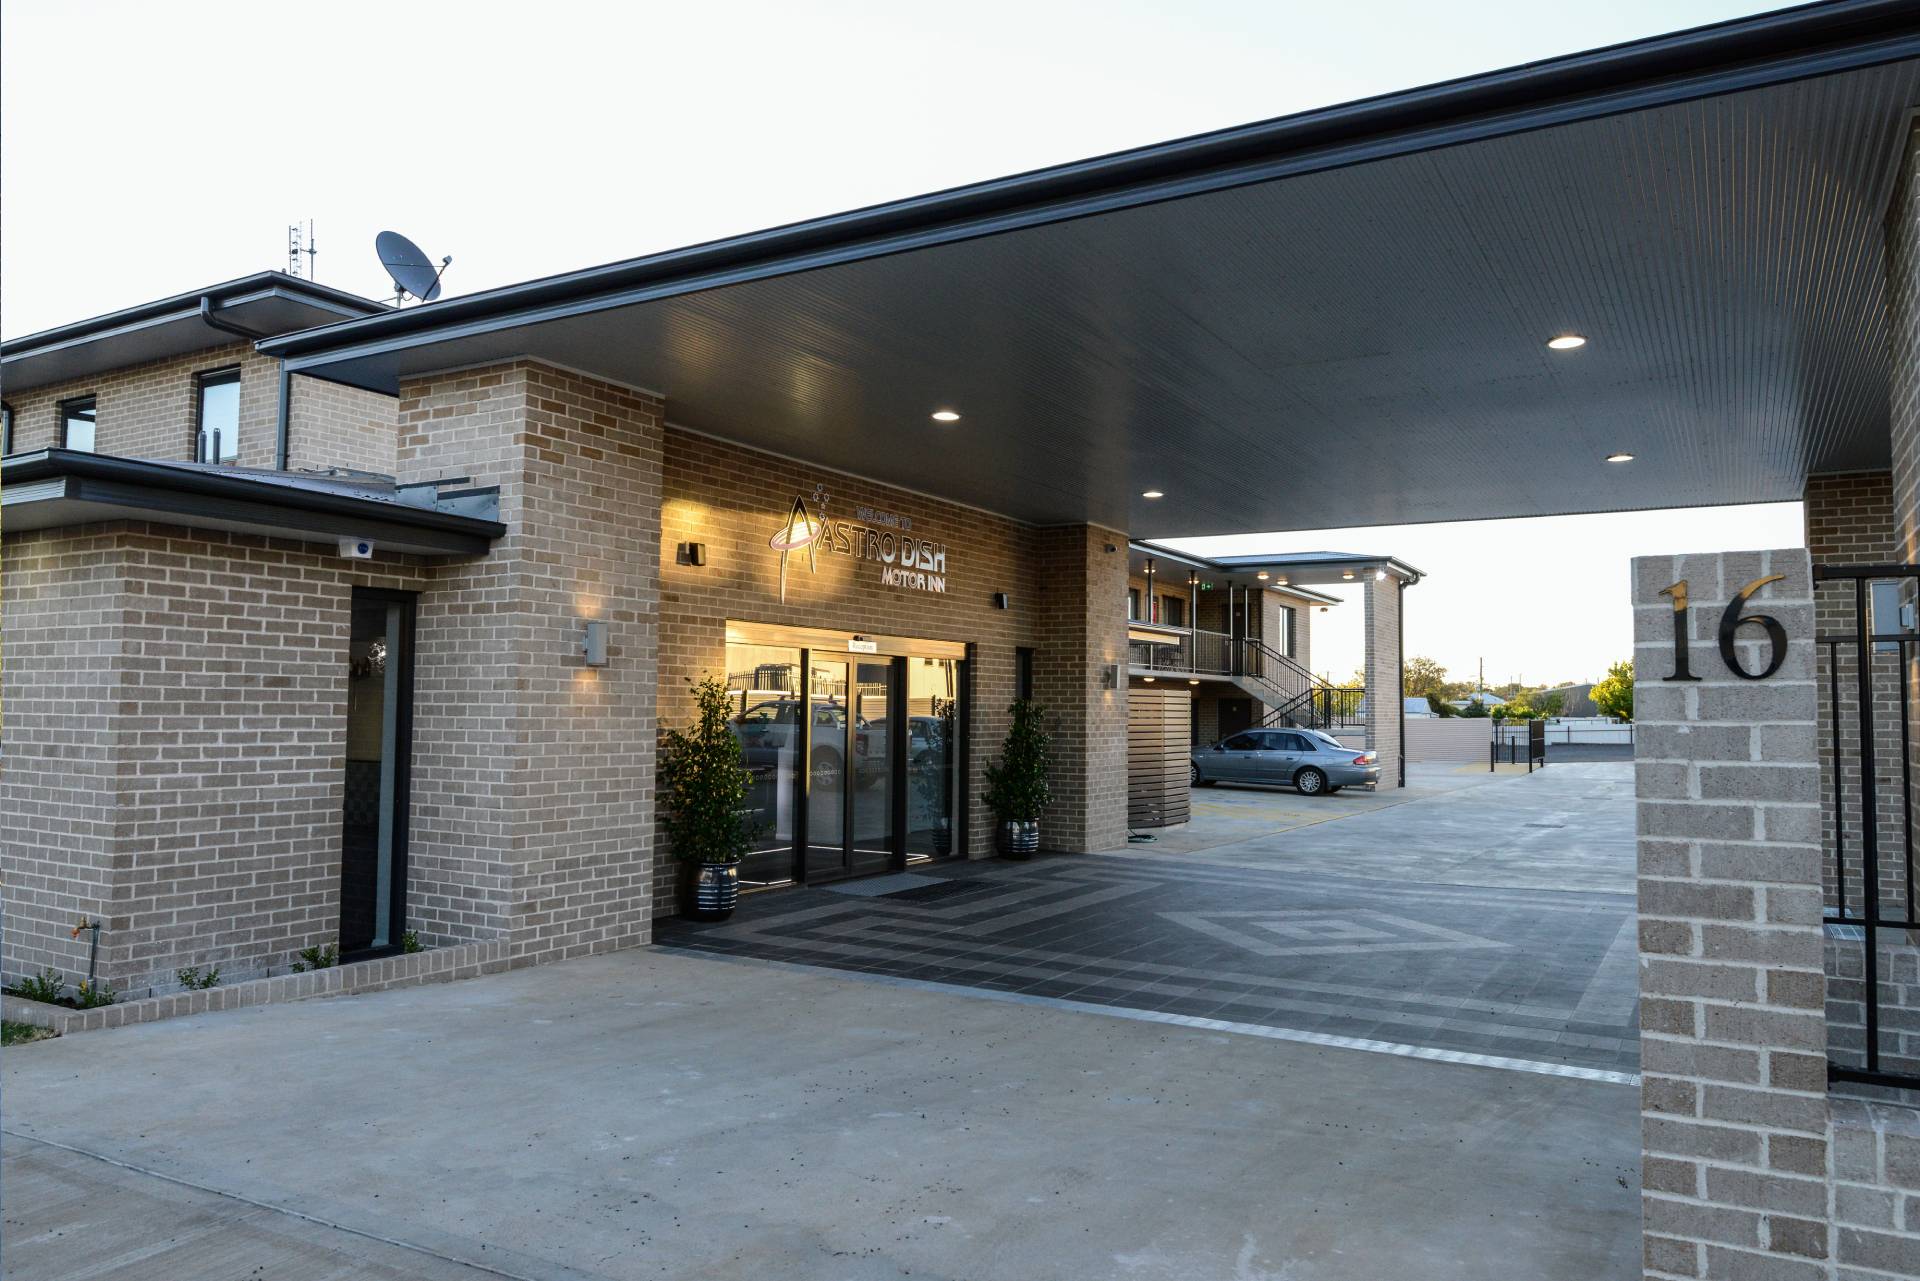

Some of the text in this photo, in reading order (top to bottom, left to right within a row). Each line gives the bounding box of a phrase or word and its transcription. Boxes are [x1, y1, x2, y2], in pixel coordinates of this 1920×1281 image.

[856, 505, 913, 531] WELCOME TO
[816, 517, 946, 574] ASTRO DISH
[881, 566, 946, 593] MOTOR INN
[1658, 572, 1788, 682] 16
